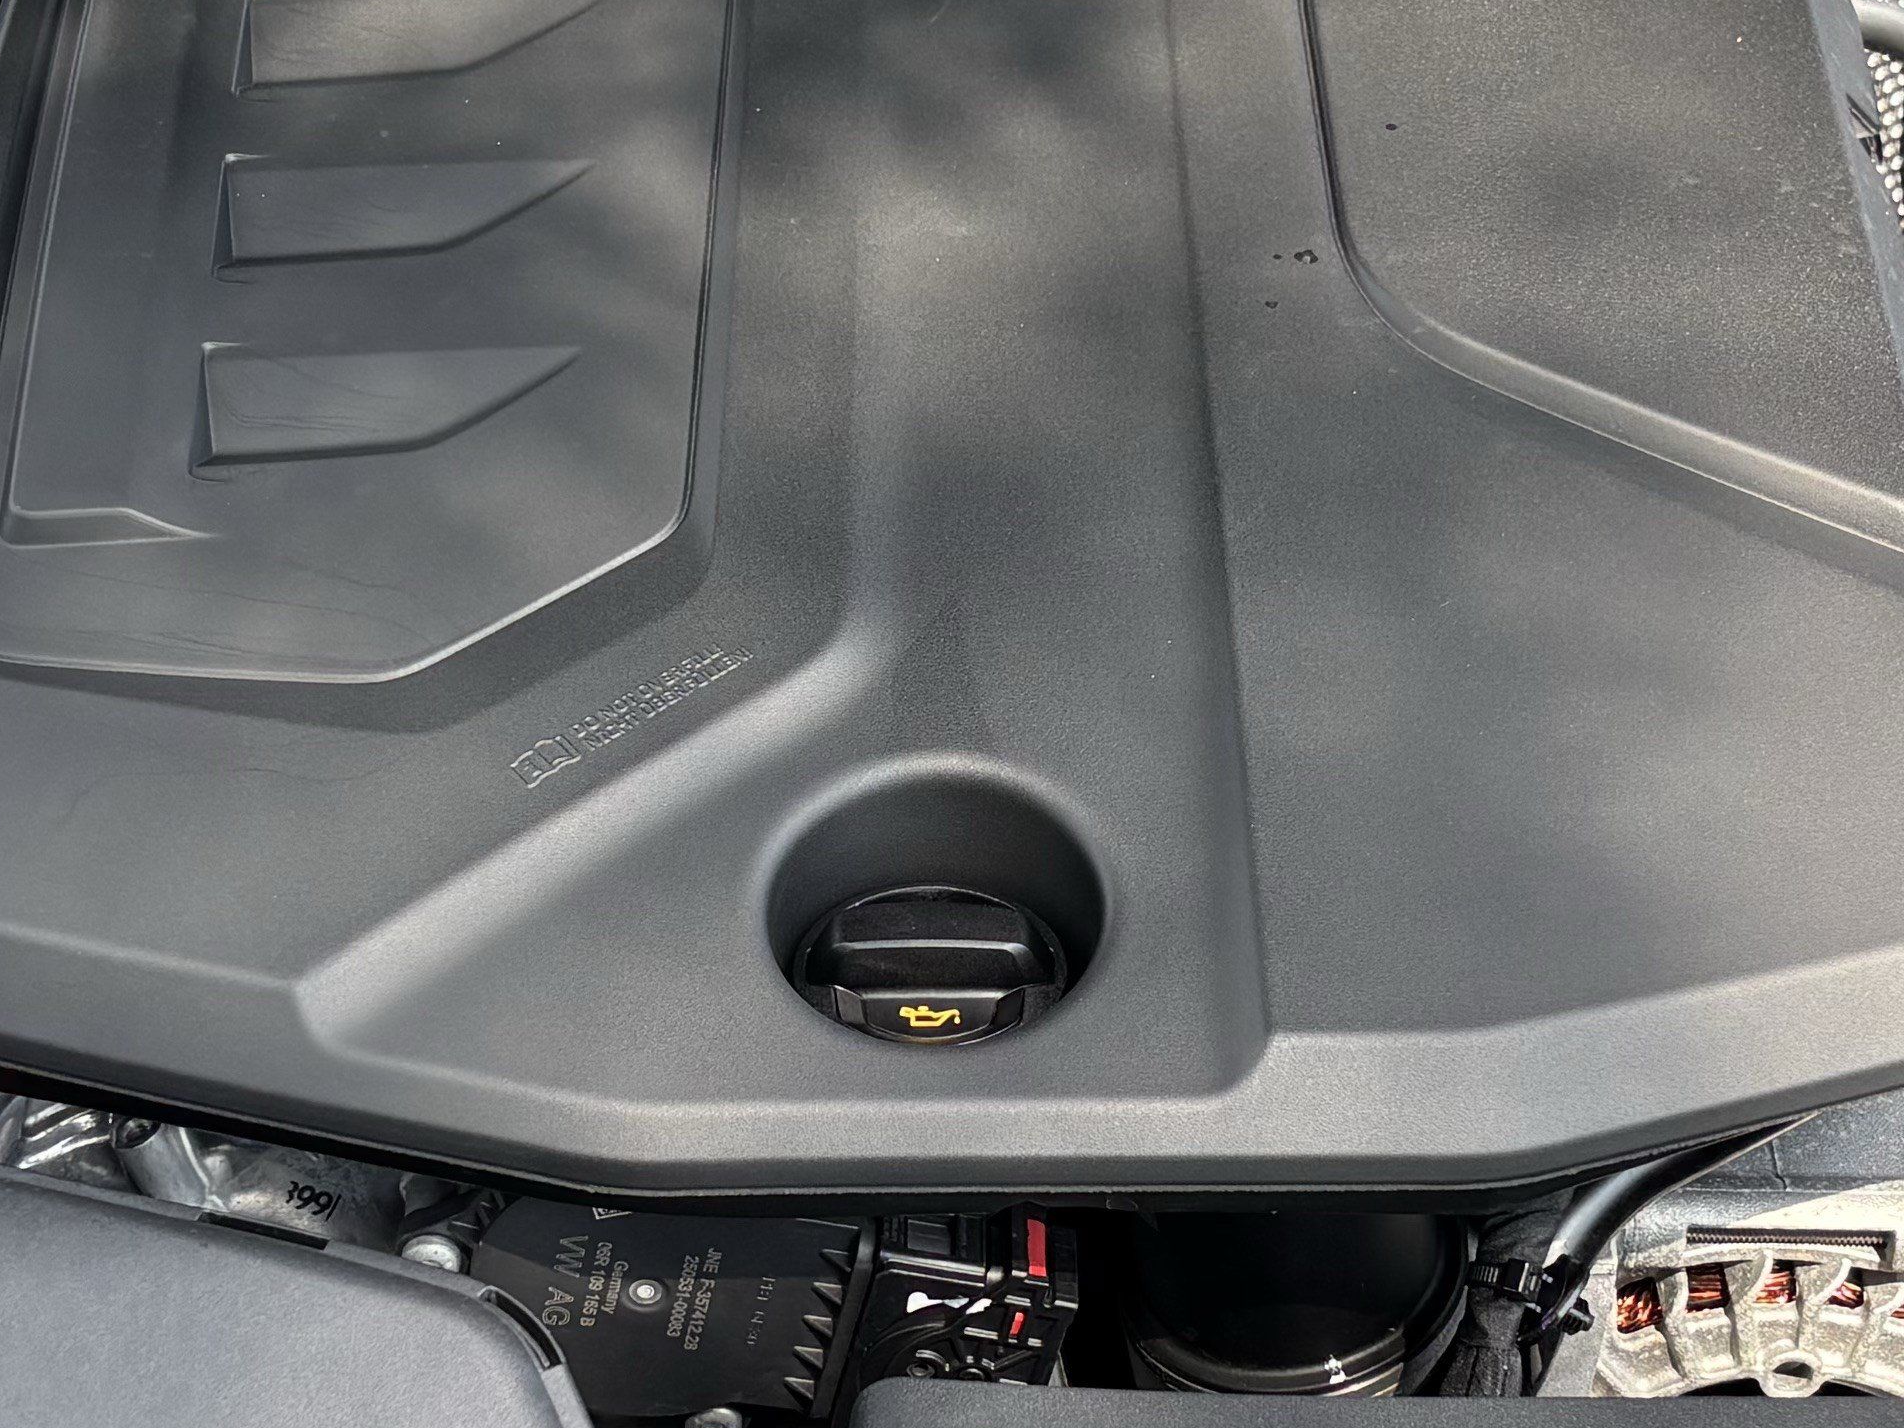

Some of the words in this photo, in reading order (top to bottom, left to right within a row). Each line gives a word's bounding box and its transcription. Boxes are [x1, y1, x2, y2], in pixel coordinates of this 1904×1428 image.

[553, 1234, 589, 1277] VW
[541, 1287, 574, 1326] AG
[601, 1259, 629, 1315] Germany
